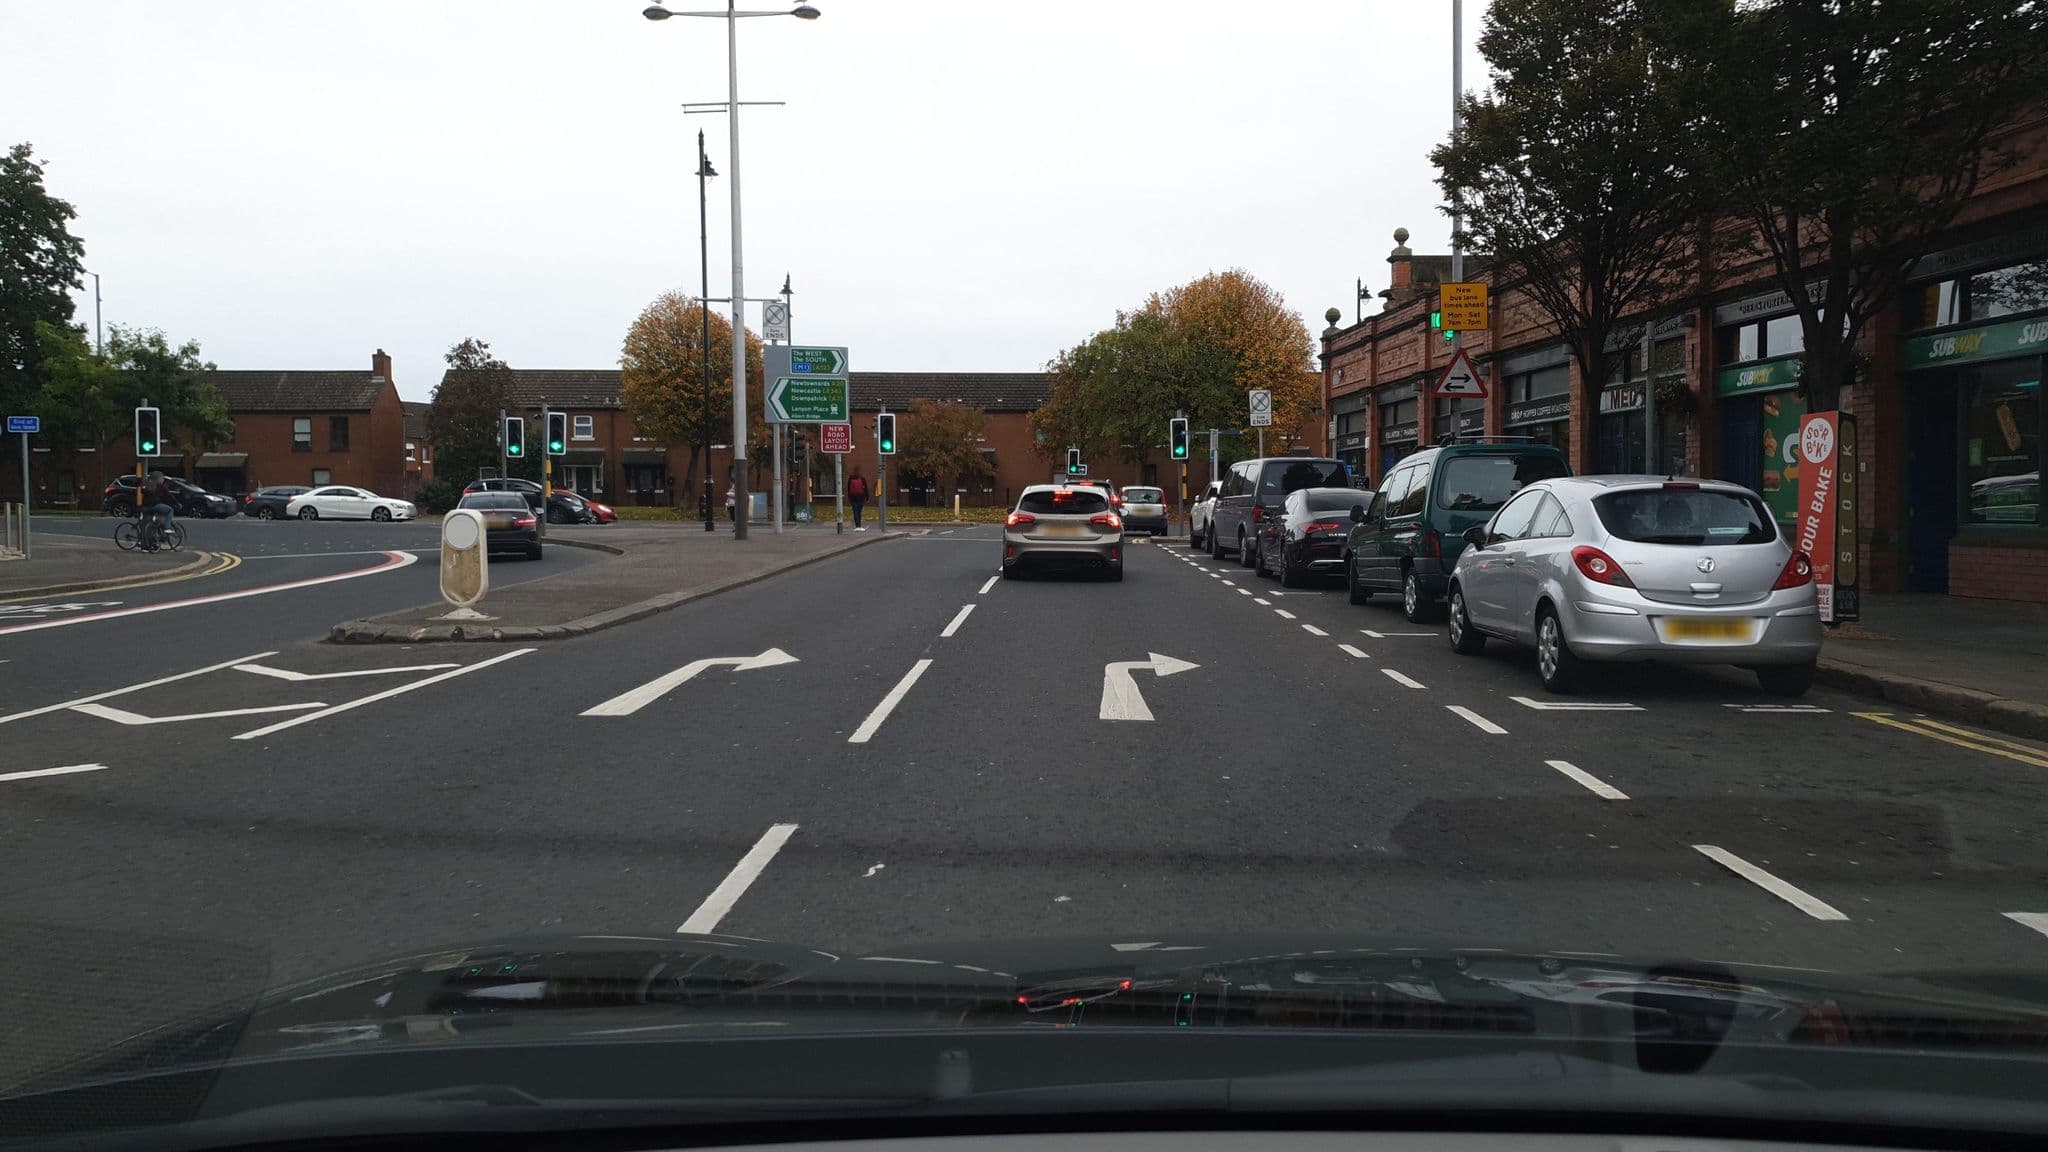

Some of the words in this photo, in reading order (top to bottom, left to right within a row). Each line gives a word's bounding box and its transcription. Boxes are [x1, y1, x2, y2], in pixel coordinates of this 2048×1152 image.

[2017, 321, 2048, 345] SUB
[1928, 333, 1985, 359] SUBWAY
[1736, 367, 1775, 388] SUBWAY
[1806, 424, 1829, 442] SOUR
[1806, 440, 1828, 458] BAKE
[1811, 466, 1832, 513] BAKE
